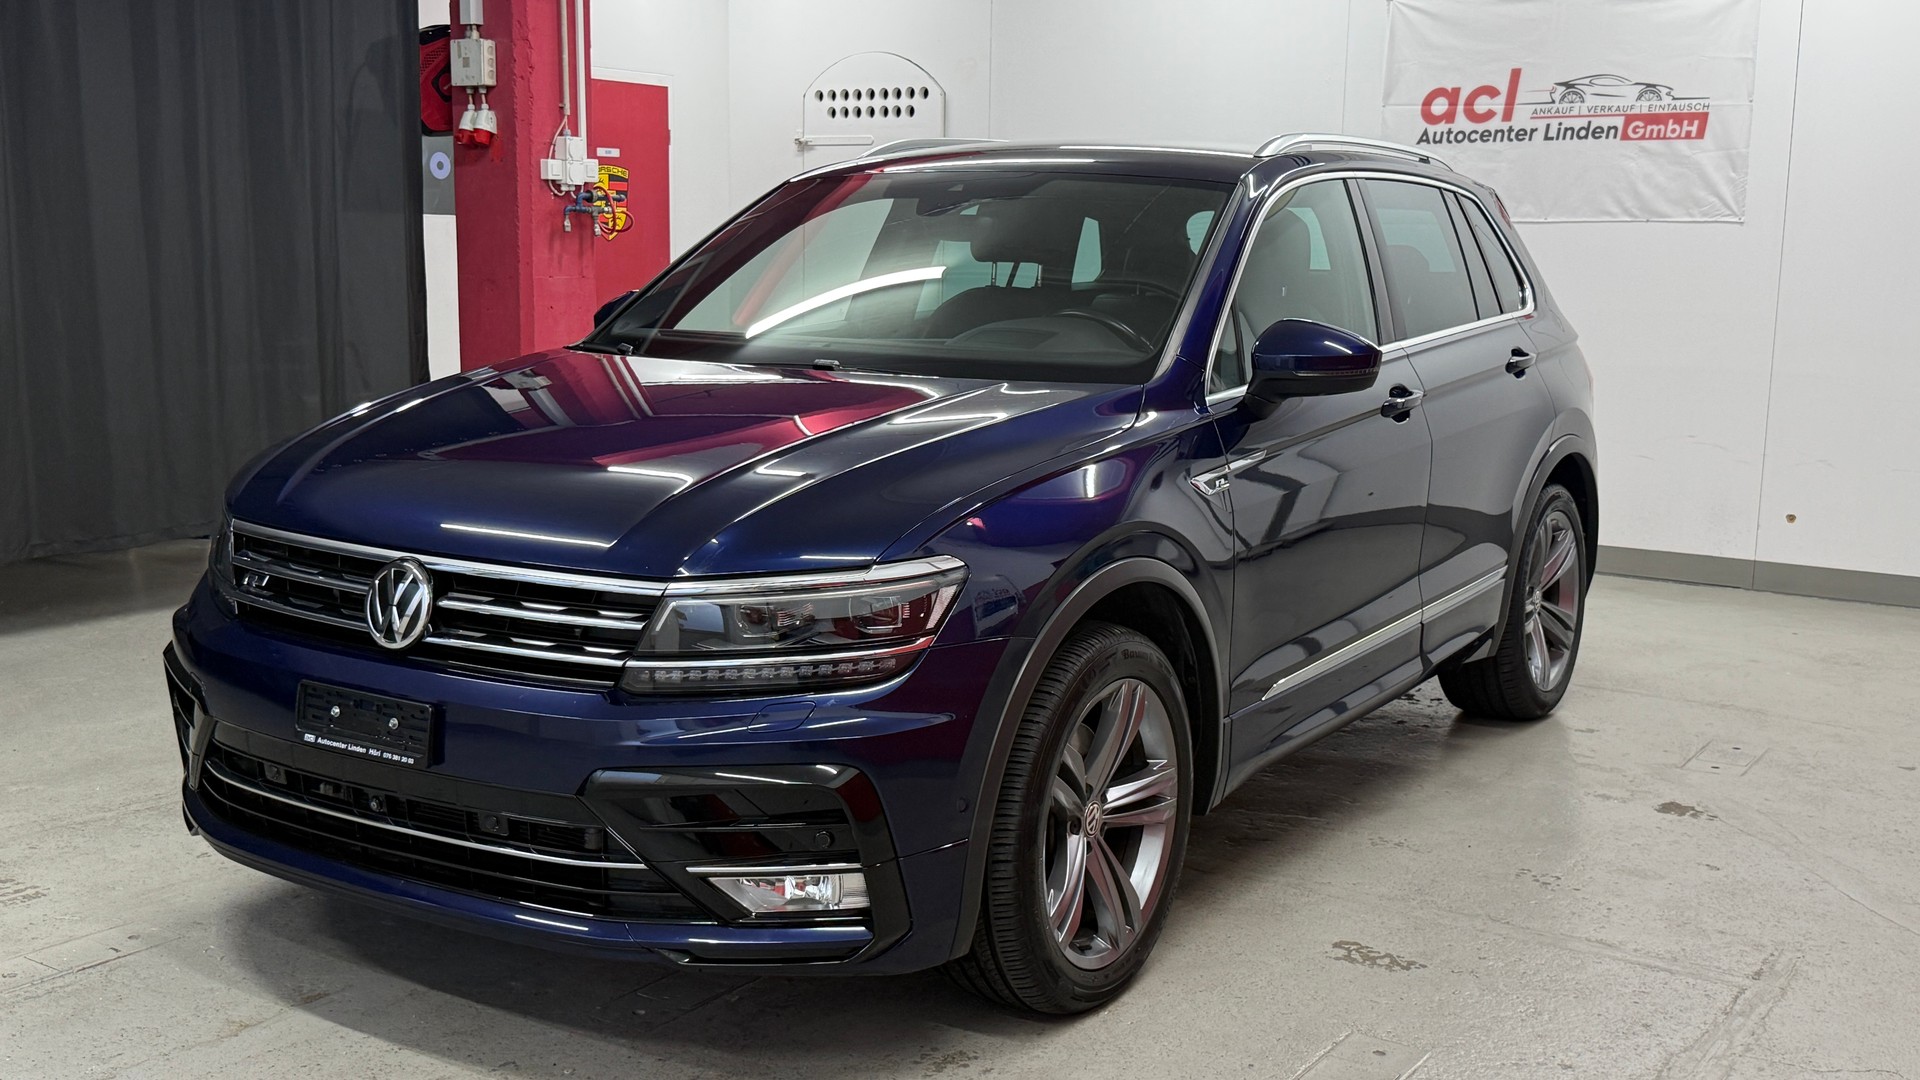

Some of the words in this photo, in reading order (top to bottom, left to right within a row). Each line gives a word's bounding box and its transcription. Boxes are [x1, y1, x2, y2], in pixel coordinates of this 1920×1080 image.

[1420, 68, 1522, 125] acl
[1531, 106, 1575, 116] ANKAUF
[1587, 104, 1636, 114] VERKAUF
[1647, 102, 1710, 113] EINTAUSCH
[1416, 124, 1538, 145] Autocenter
[1543, 120, 1619, 142] Linden
[1626, 119, 1699, 139] GmbH
[317, 737, 347, 749] Autocenter
[348, 744, 366, 753] Linden
